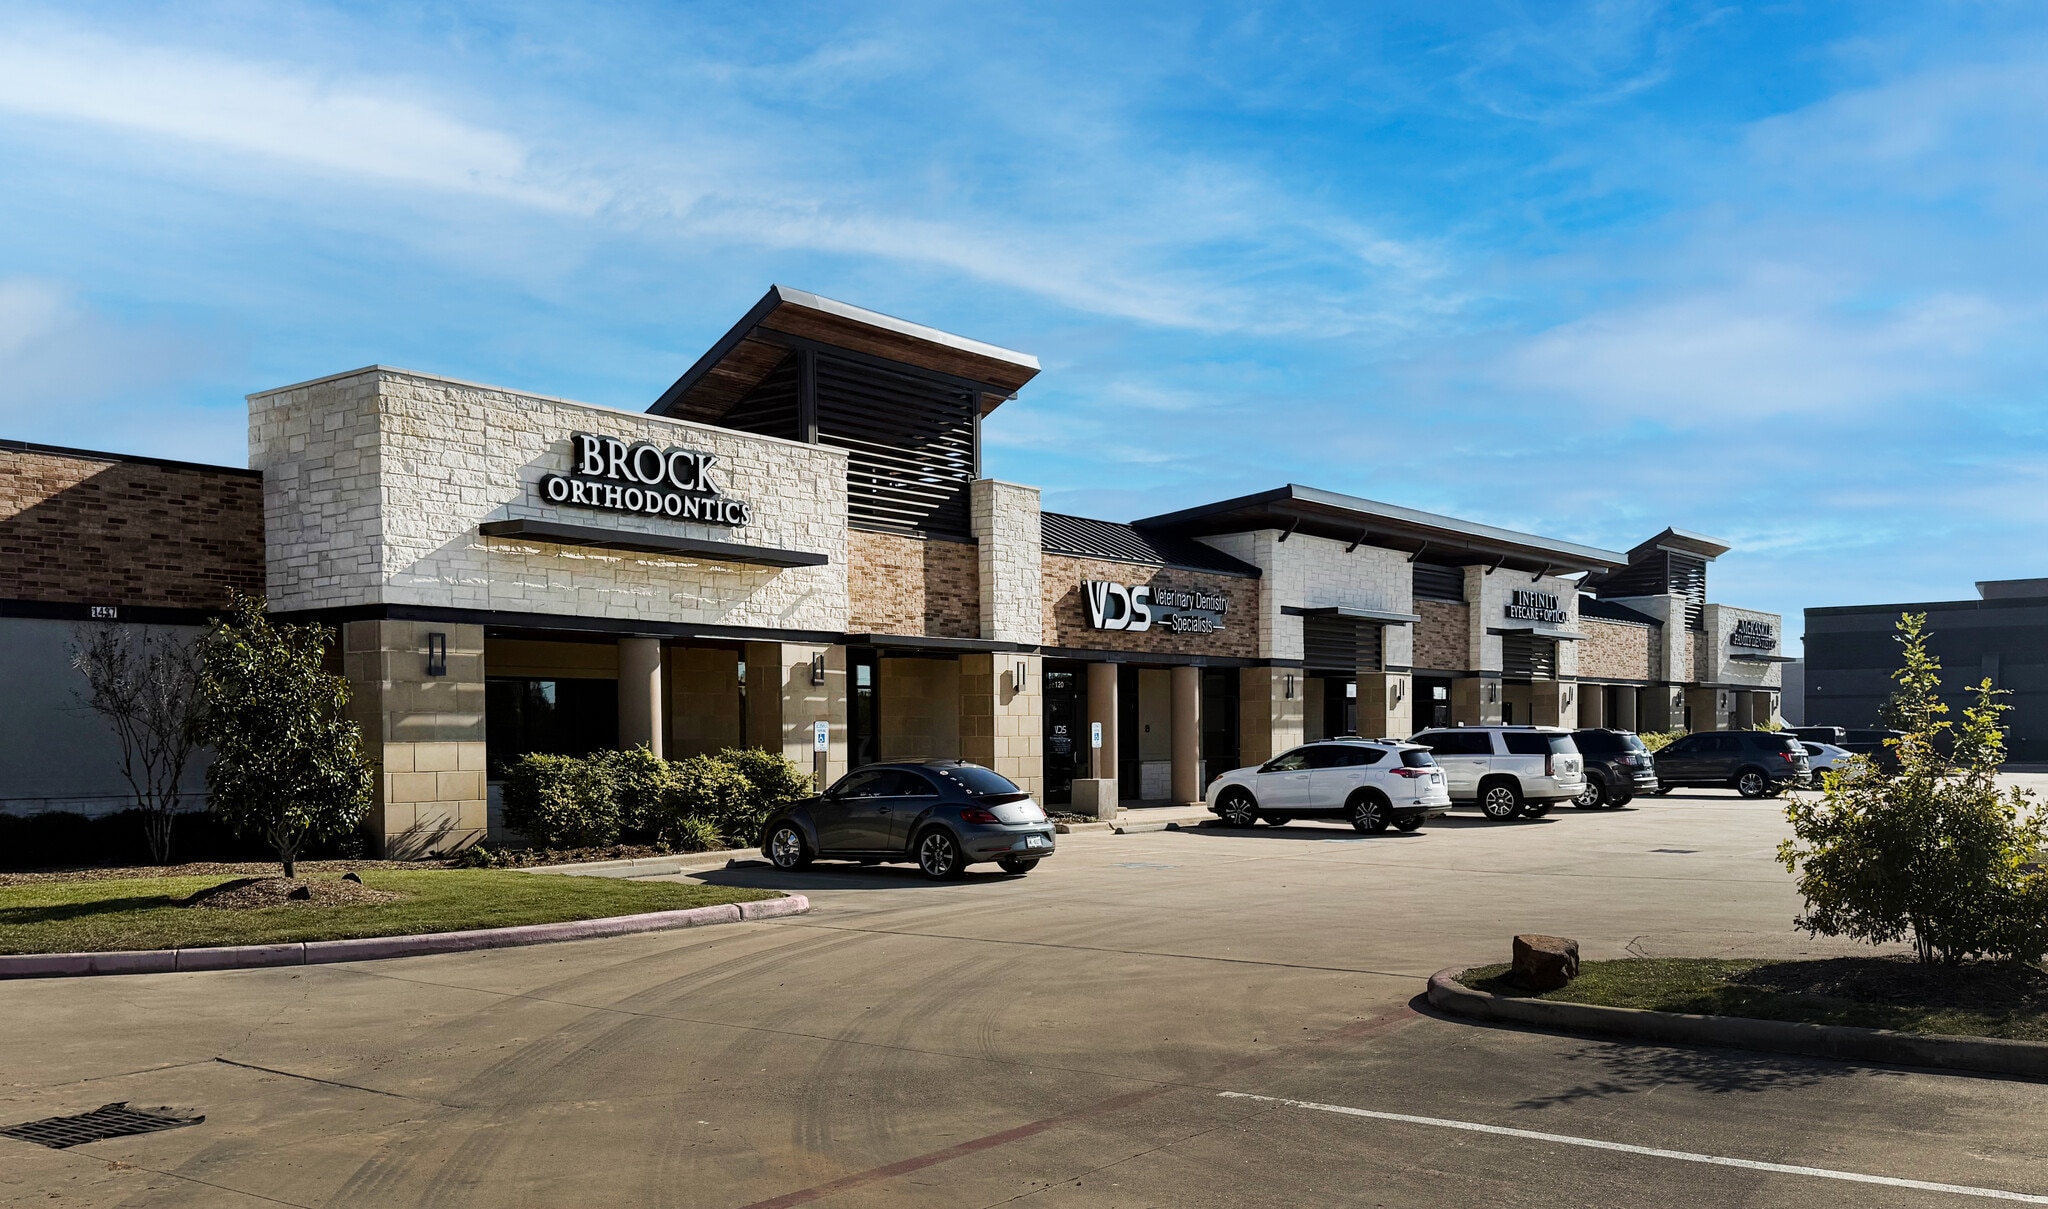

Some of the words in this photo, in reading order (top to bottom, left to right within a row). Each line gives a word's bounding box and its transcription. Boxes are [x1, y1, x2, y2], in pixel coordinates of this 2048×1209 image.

[579, 434, 720, 494] BROCK
[548, 477, 750, 526] ORTHODONTICS
[1087, 580, 1151, 632] VDS
[1153, 585, 1194, 611] Veterinary
[1196, 592, 1229, 615] Dentistry
[1510, 605, 1538, 620] EYECARE
[1519, 590, 1559, 609] INFINITY
[1172, 613, 1213, 634] Specialists
